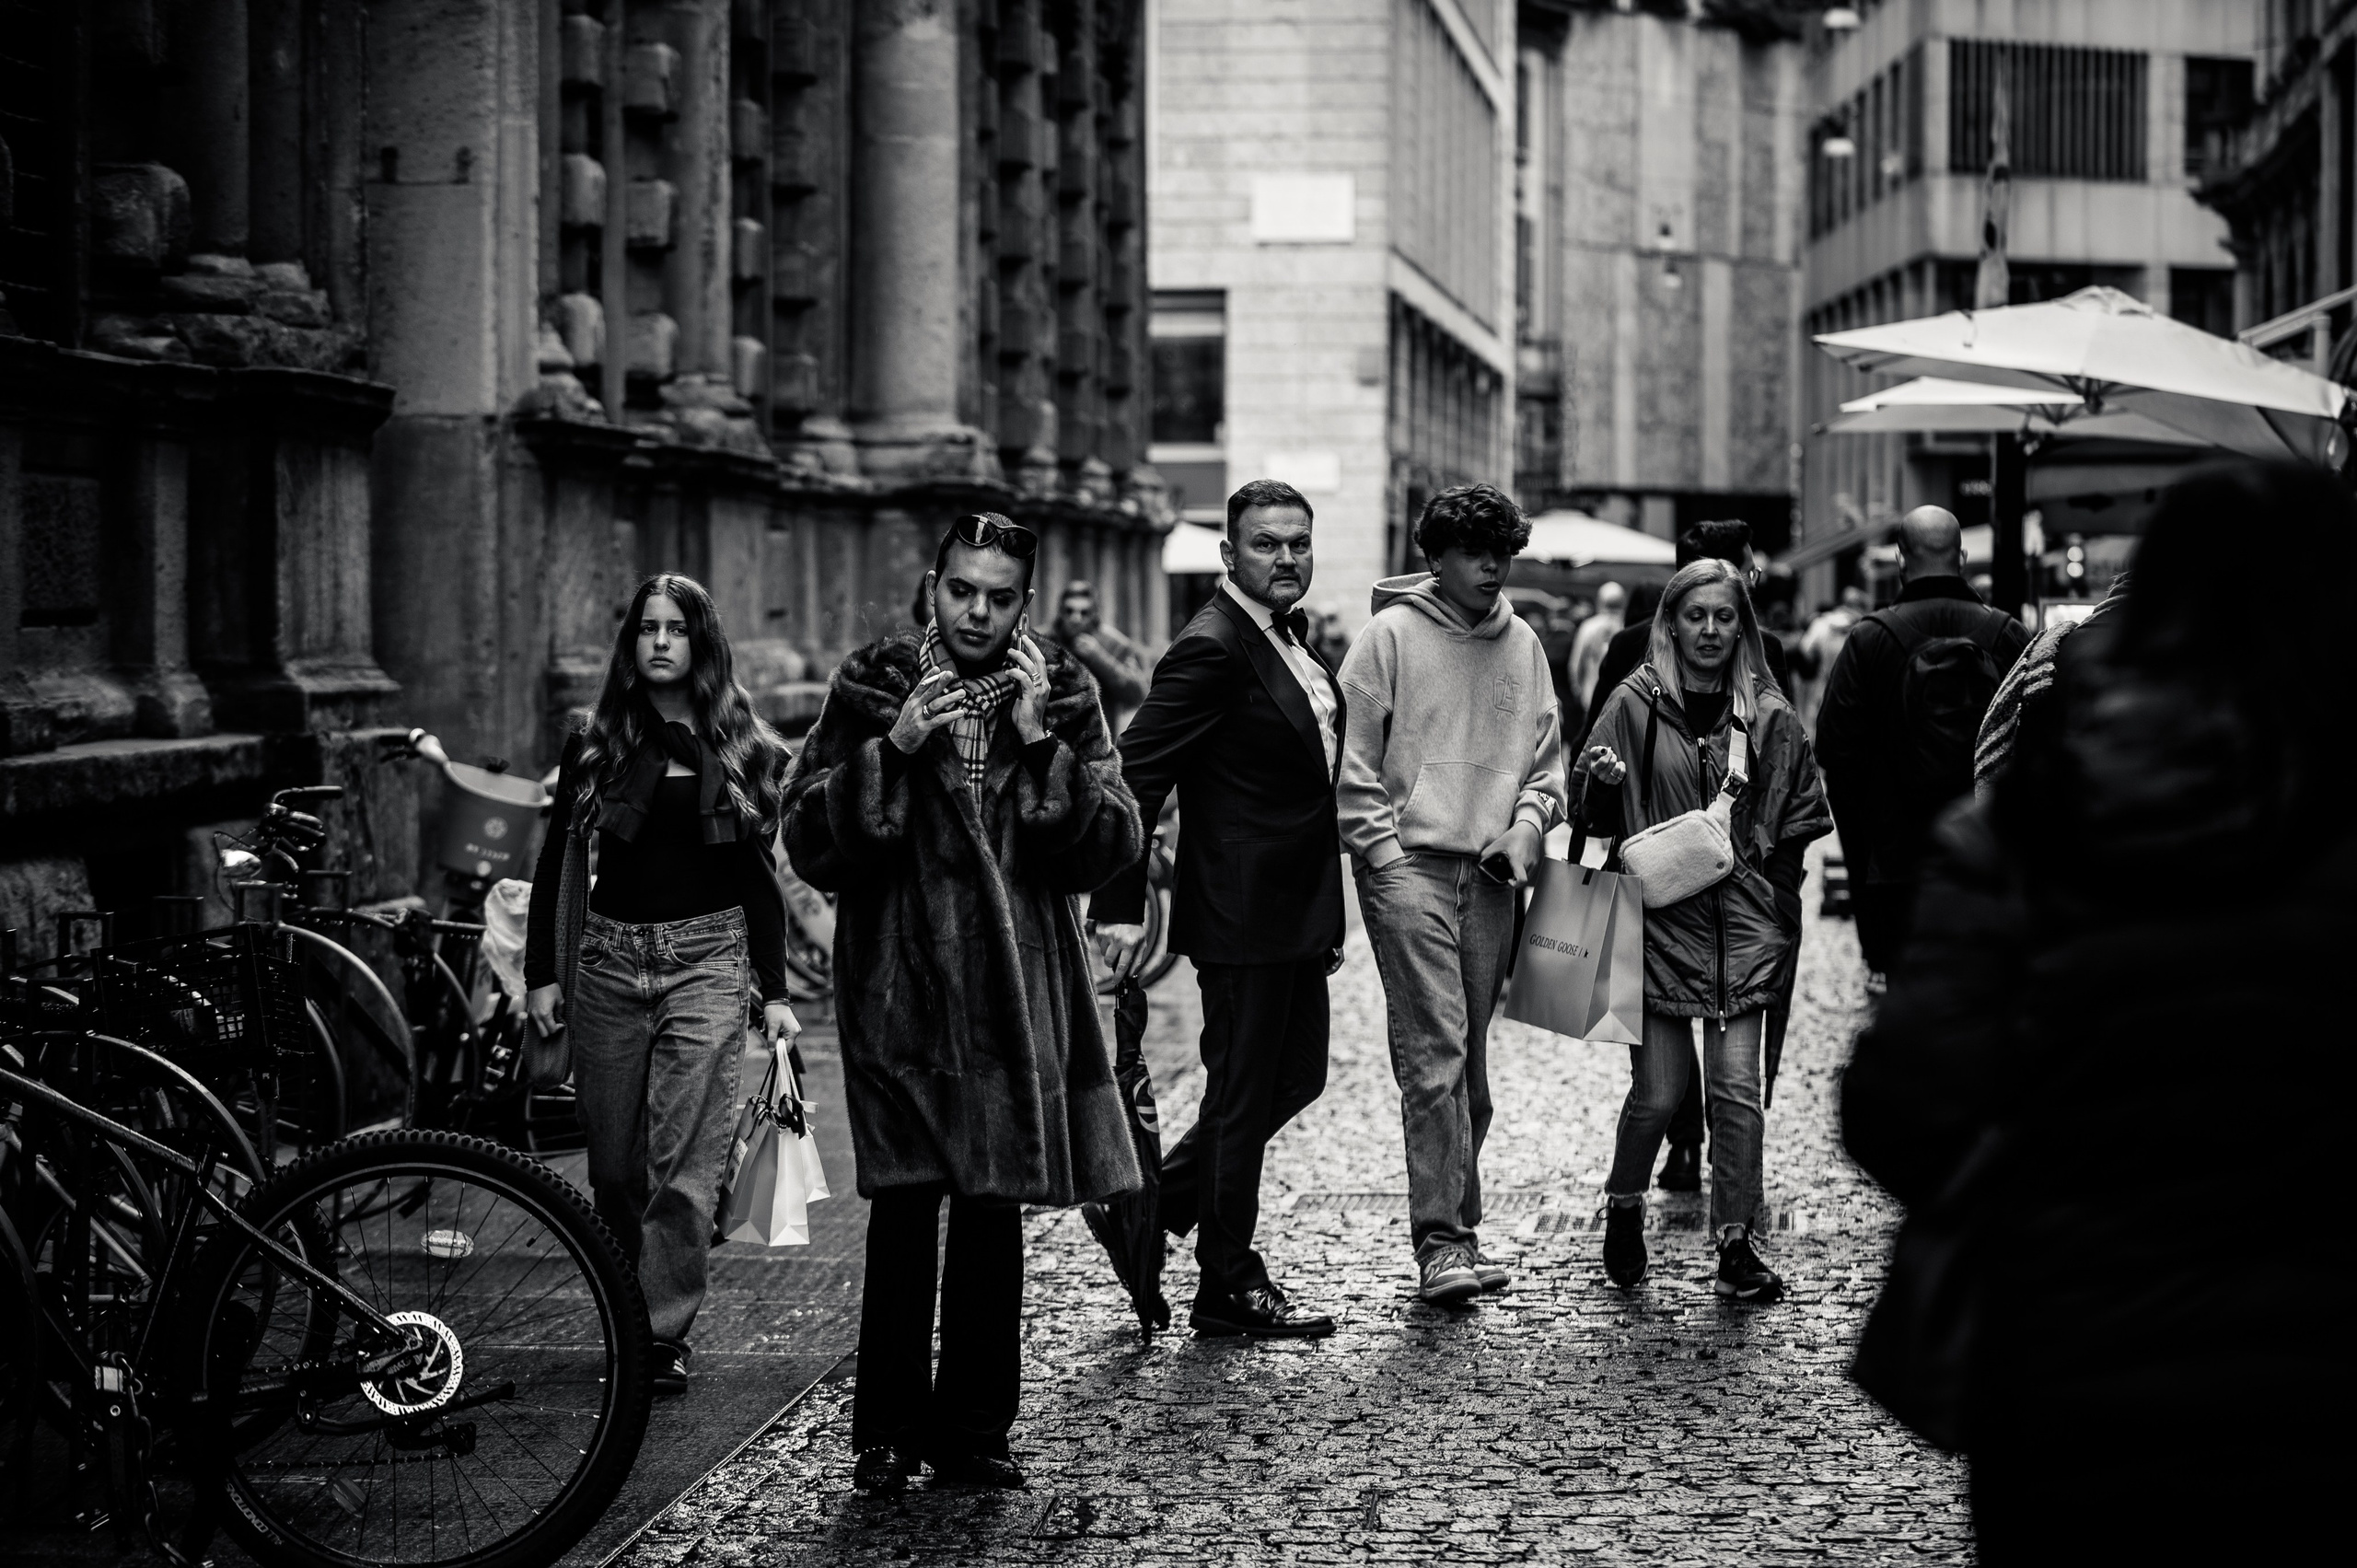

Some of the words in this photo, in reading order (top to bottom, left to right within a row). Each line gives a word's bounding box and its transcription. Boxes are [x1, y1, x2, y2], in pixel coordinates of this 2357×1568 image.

[1529, 934, 1558, 950] GOLDEN
[1557, 941, 1579, 957] GOOSE
[225, 1482, 270, 1534] CONDITIONS
